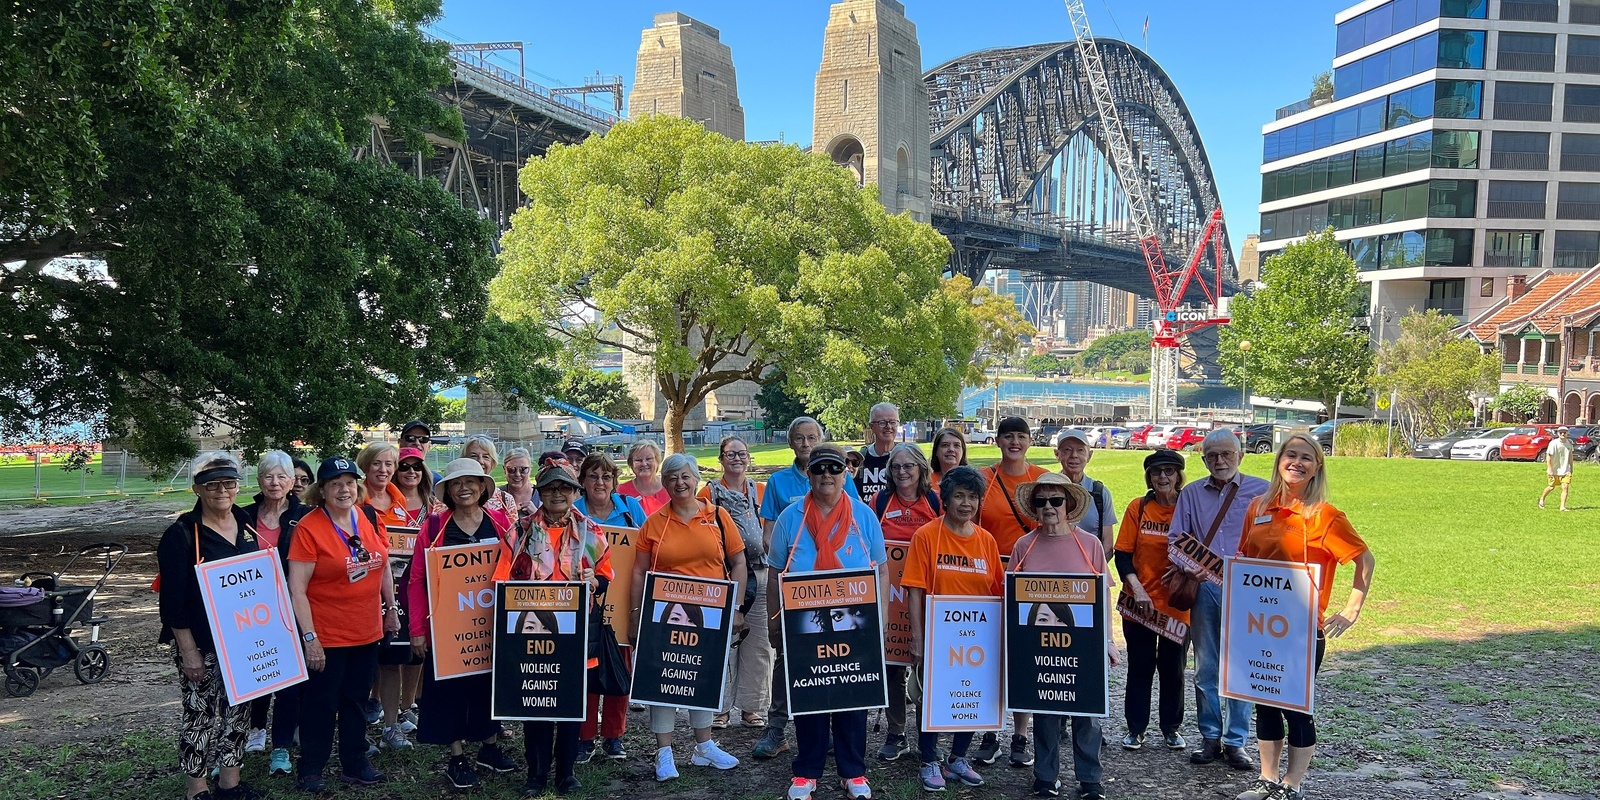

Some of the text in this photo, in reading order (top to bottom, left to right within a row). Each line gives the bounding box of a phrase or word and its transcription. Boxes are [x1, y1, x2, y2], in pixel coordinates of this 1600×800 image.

[1177, 312, 1206, 321] ICON
[1141, 520, 1170, 532] ZONTA
[1169, 546, 1177, 554] TO
[1177, 551, 1200, 570] VIOLENC
[1173, 532, 1224, 575] ZONTA
[937, 553, 968, 567] ZONTA
[974, 558, 987, 569] NO
[219, 568, 263, 588] ZONTA
[465, 574, 487, 584] SAYS
[1243, 573, 1292, 591] ZONTA
[662, 580, 695, 595] ZONTA
[706, 585, 721, 598] NO
[791, 580, 867, 600] ZONTA SAYS NO
[889, 583, 908, 603] N
[1024, 580, 1060, 592] ZONTA
[1072, 581, 1089, 593] NO
[239, 589, 256, 599] SAYS
[458, 588, 495, 612] NO
[514, 588, 546, 600] ZONTA
[558, 589, 573, 600] NO
[1259, 596, 1278, 605] SAYS
[233, 603, 272, 631] NO
[472, 617, 486, 626] TO
[944, 610, 987, 623] ZONTA
[1123, 608, 1144, 625] VIOLENCE
[1144, 620, 1164, 636] AGAINST
[1164, 631, 1183, 645] WOMEN
[1166, 616, 1187, 638] NO
[1247, 611, 1289, 638] NO
[454, 629, 493, 642] VIOLEN
[670, 630, 699, 647] END
[1041, 632, 1072, 648] END
[254, 640, 265, 648] TO
[460, 643, 493, 655] AGAIN
[526, 639, 555, 655] END
[247, 647, 278, 662] VIOLENCE
[817, 643, 850, 659] END
[886, 648, 910, 657] WOM
[948, 645, 985, 667] NO
[1261, 649, 1272, 658] TO
[252, 658, 279, 673] AGAINST
[463, 655, 492, 667] WOM
[662, 652, 702, 666] VIOLENCE
[1034, 655, 1078, 668] VIOLENCE
[520, 663, 560, 674] VIOLENCE
[810, 662, 860, 675] VIOLENCE
[1248, 660, 1285, 672] VIOLENCE
[255, 670, 281, 683] WOMEN
[661, 668, 698, 681] AGAINST
[793, 672, 880, 688] AGAINST WOMEN
[1037, 672, 1076, 684] AGAINST
[1250, 672, 1282, 683] AGAINST
[522, 680, 558, 690] AGAINST
[660, 683, 695, 697] WOMEN
[1250, 683, 1281, 695] WOMEN
[949, 690, 982, 698] VIOLENCE
[1038, 689, 1076, 702] WOMEN
[522, 696, 557, 707] WOMEN
